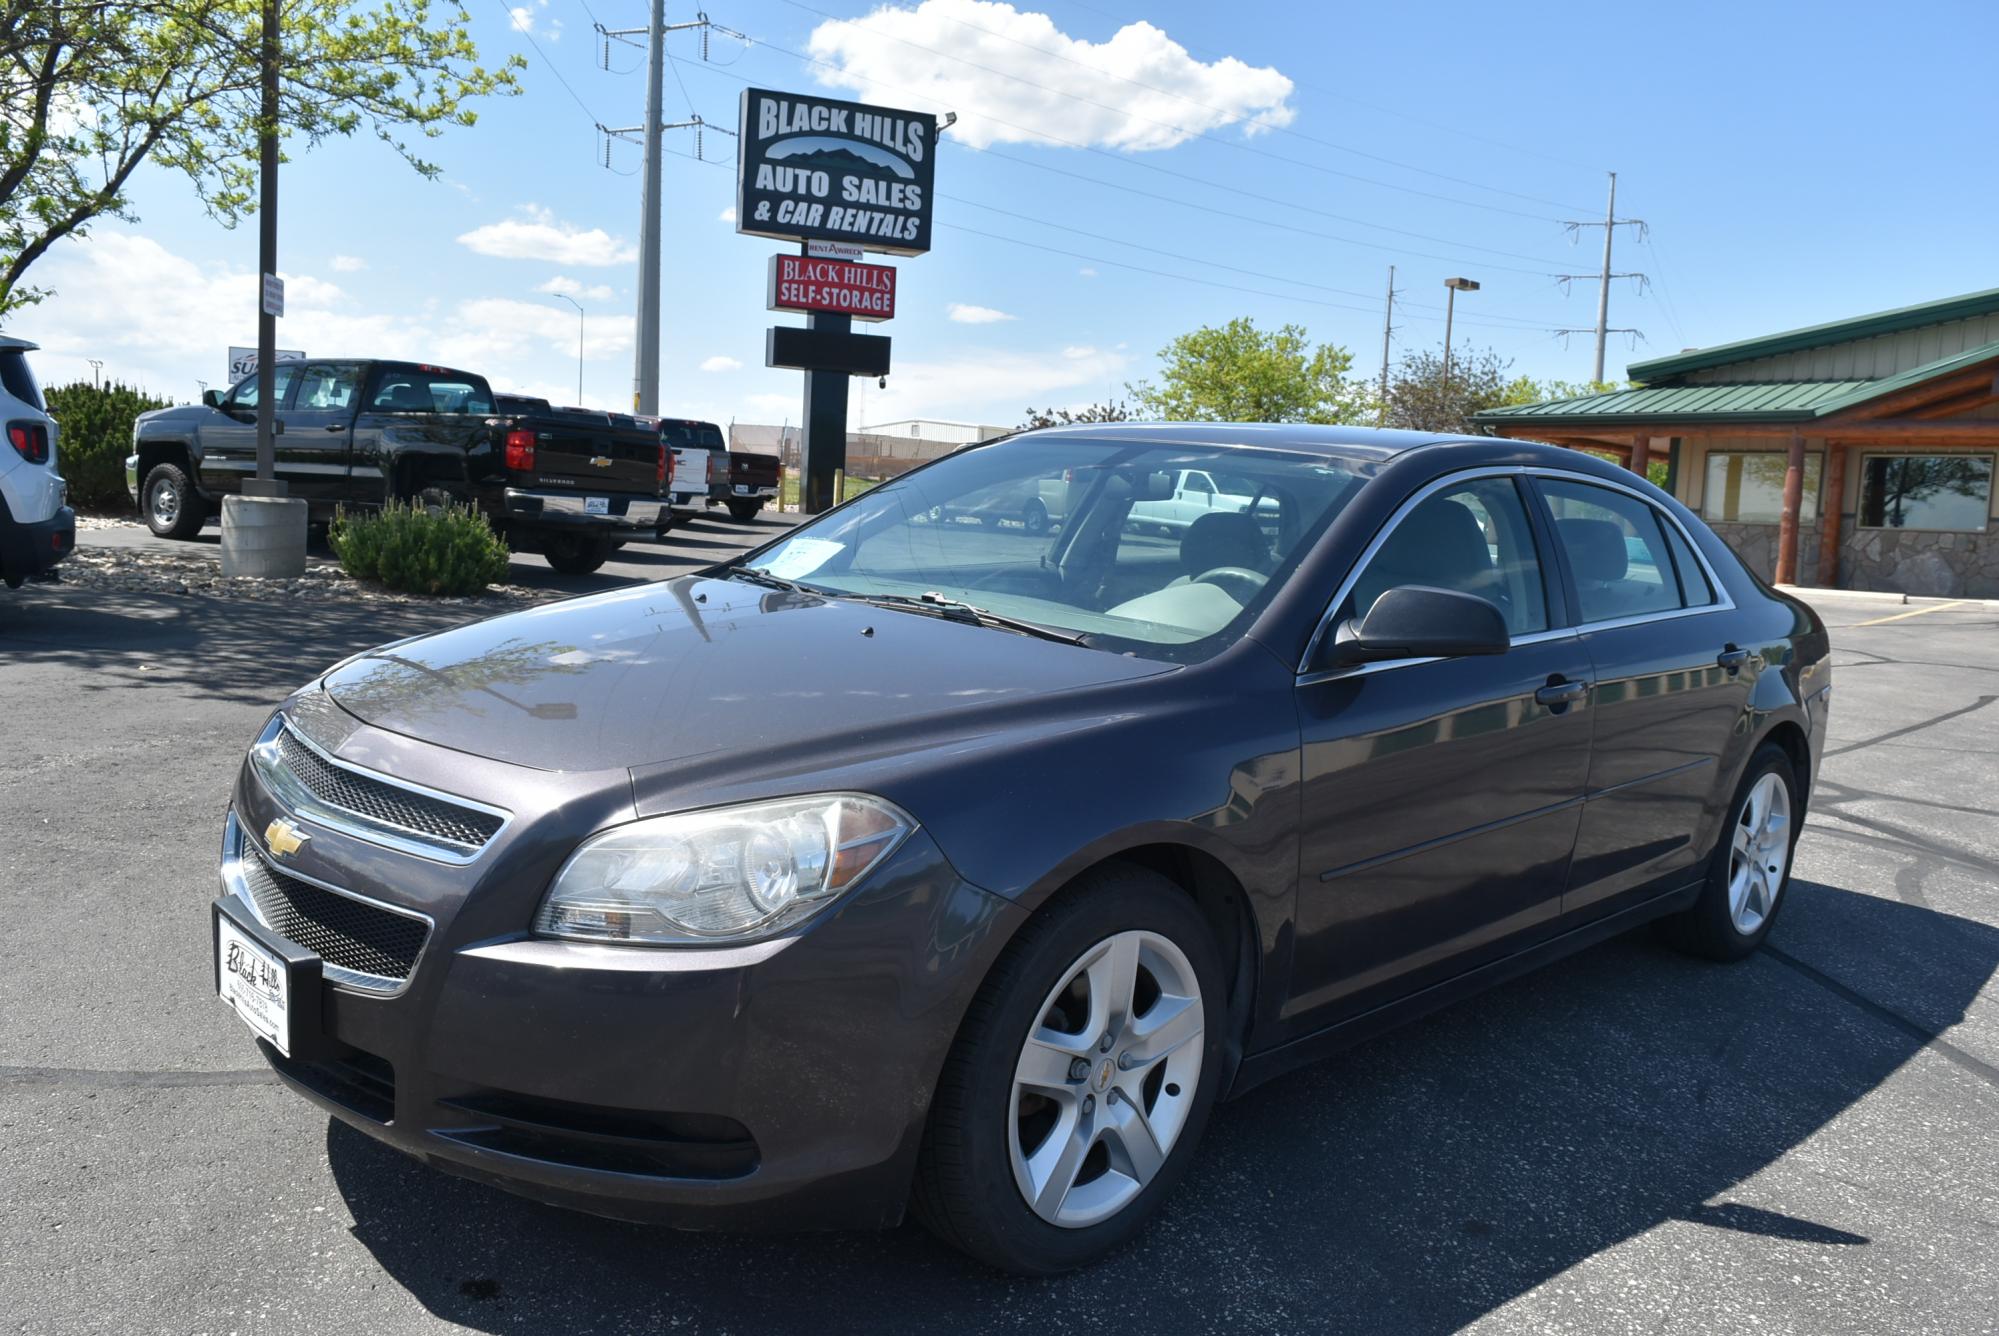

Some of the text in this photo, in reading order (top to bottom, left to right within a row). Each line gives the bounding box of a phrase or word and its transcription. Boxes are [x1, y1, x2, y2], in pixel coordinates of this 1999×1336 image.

[758, 97, 924, 162] BLACK HILLS
[755, 163, 922, 211] AUTO SALES
[754, 199, 920, 241] & CAR RENTALS
[781, 282, 891, 312] SELF-STORAGE
[783, 259, 891, 292] BLACK HILLS
[226, 941, 281, 992] Black Hills
